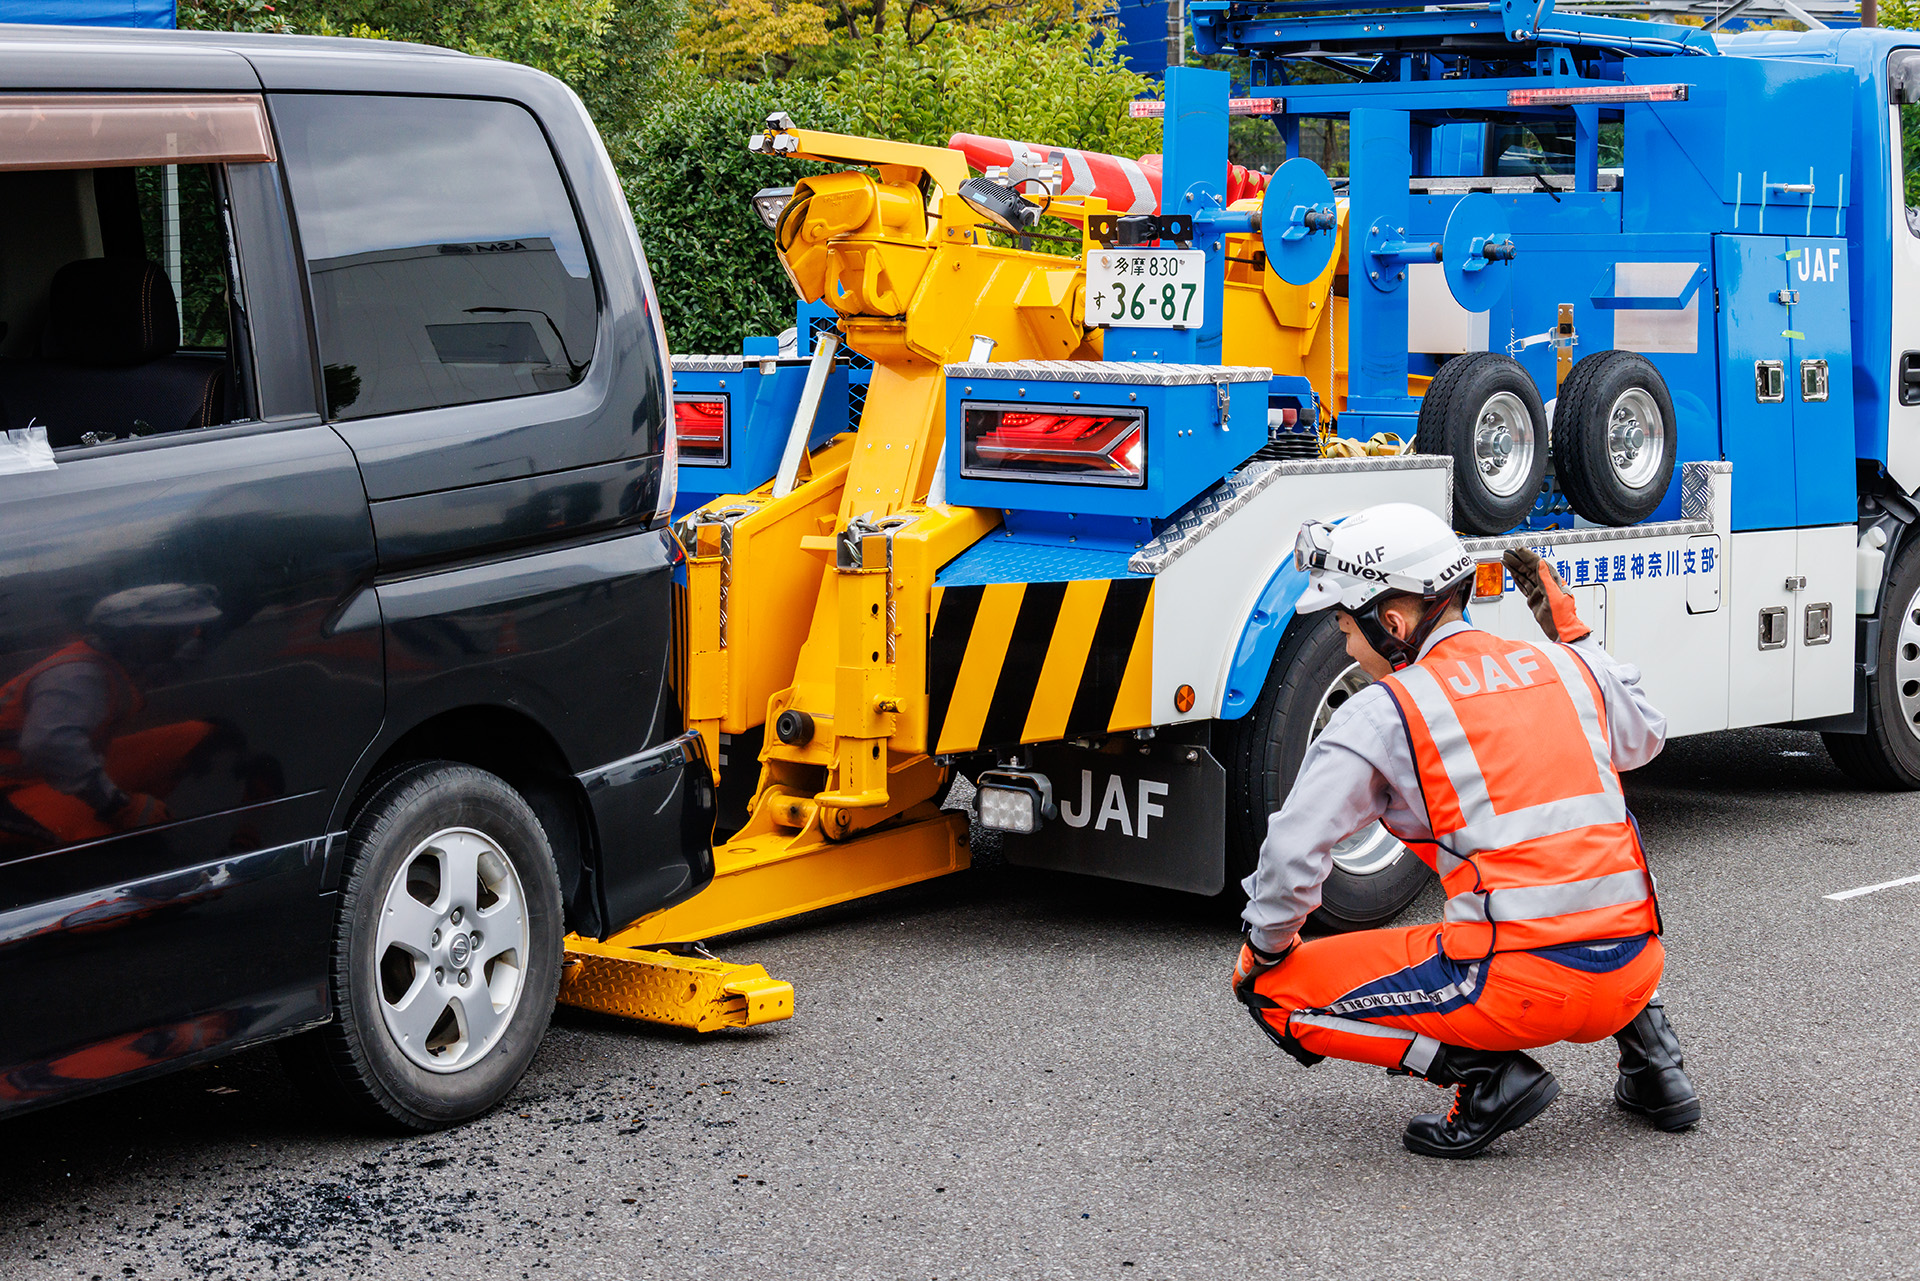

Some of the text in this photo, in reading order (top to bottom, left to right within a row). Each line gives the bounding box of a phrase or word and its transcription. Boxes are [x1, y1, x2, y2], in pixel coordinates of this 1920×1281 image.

[1114, 256, 1178, 276] 多摩 830
[1797, 247, 1840, 282] JAF
[1093, 282, 1197, 321] す 36-87
[1337, 559, 1391, 584] uvex
[1504, 547, 1715, 592] 日動車連盟神奈川支部
[1448, 648, 1540, 695] JAF
[1060, 769, 1169, 839] JAF
[1337, 993, 1412, 1012] AUTOMOBILE
